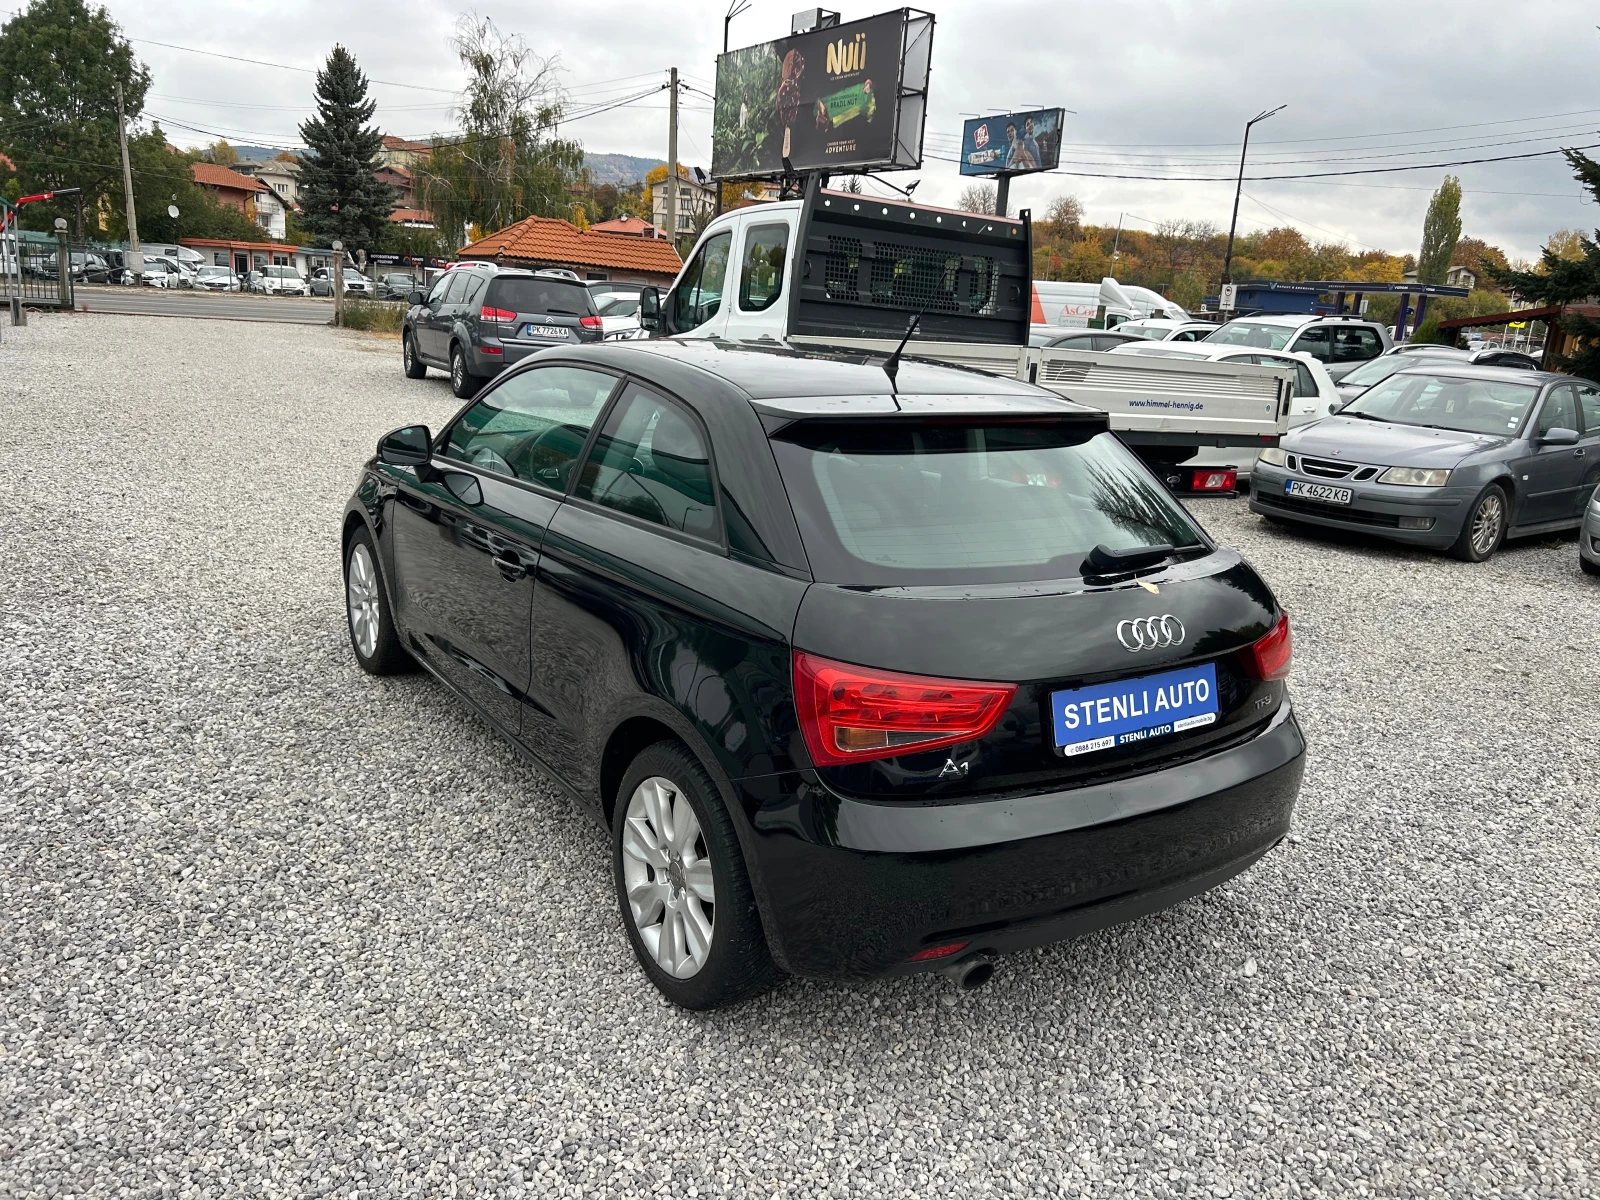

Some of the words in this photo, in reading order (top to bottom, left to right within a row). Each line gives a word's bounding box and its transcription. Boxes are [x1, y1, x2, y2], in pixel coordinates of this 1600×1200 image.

[830, 100, 846, 109] BRAZIL
[847, 97, 857, 107] NUT
[825, 144, 857, 153] ADVENTURE
[531, 326, 541, 334] PK
[542, 327, 558, 336] 7726
[559, 328, 568, 336] KA
[1129, 399, 1203, 411] www.himmel-hennig.de
[1291, 482, 1305, 494] PK
[1307, 485, 1332, 499] 4622
[1333, 489, 1349, 501] KB
[1064, 691, 1148, 729] STENLI
[1154, 678, 1210, 712] AUTO
[1119, 730, 1147, 743] STENLI
[1148, 724, 1171, 737] AUTO
[1090, 741, 1100, 749] 215
[1101, 739, 1112, 747] 697
[938, 758, 969, 778] A1
